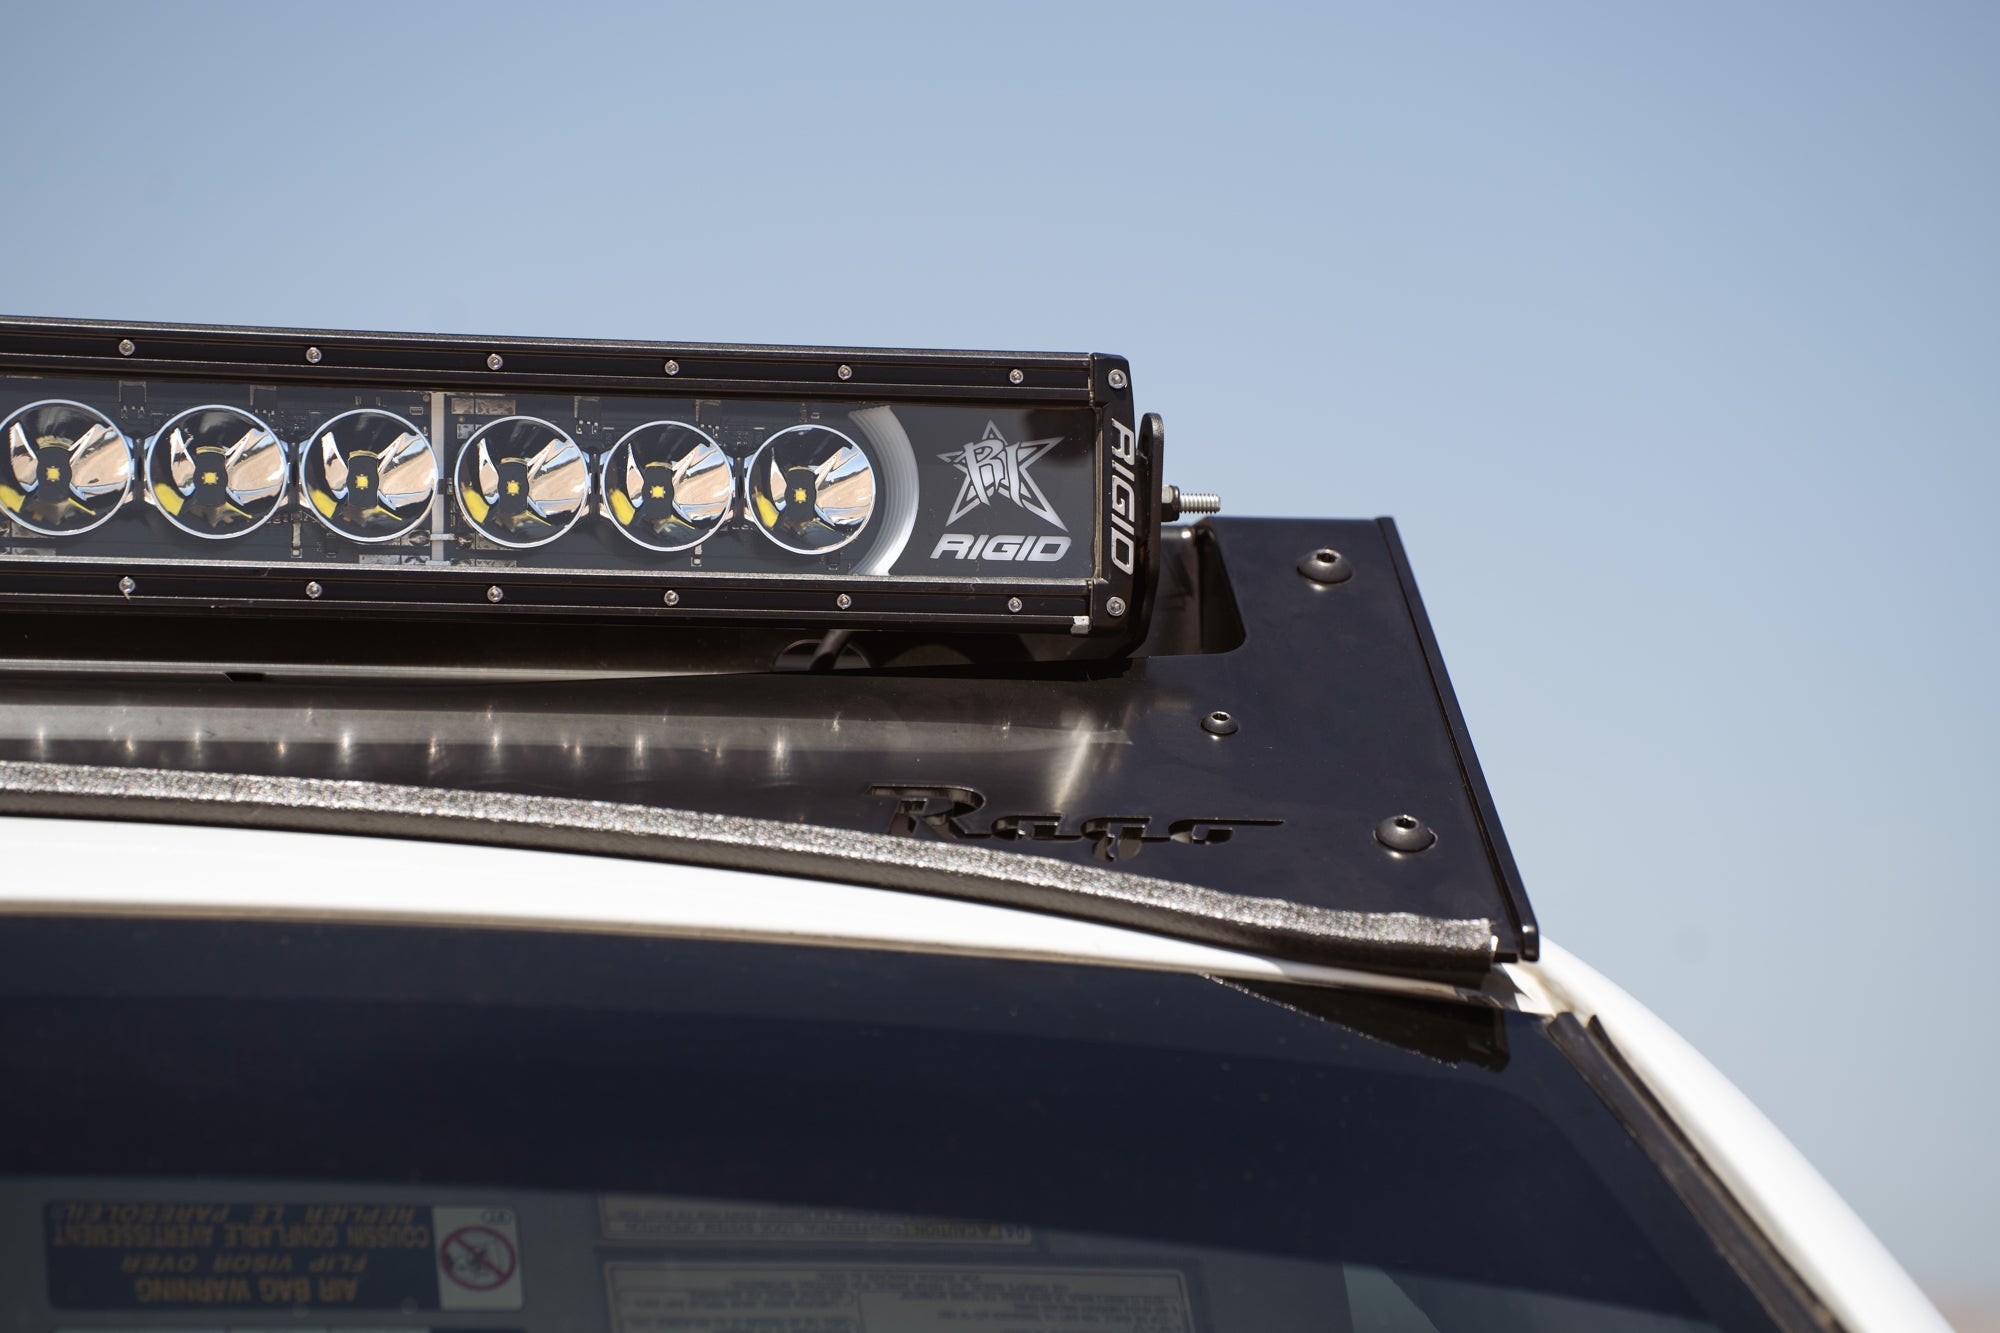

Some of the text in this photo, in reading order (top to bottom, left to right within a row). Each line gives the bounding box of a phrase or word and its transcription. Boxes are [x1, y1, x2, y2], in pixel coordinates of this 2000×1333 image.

[1111, 418, 1136, 576] RIGID
[930, 533, 1072, 562] RIGID
[863, 784, 1287, 863] Rago
[250, 1203, 285, 1223] LE
[346, 1224, 429, 1248] COUSSIN
[121, 1254, 367, 1273] FLIP VISOR OVER
[134, 1277, 358, 1302] AIR BAG WARNING
